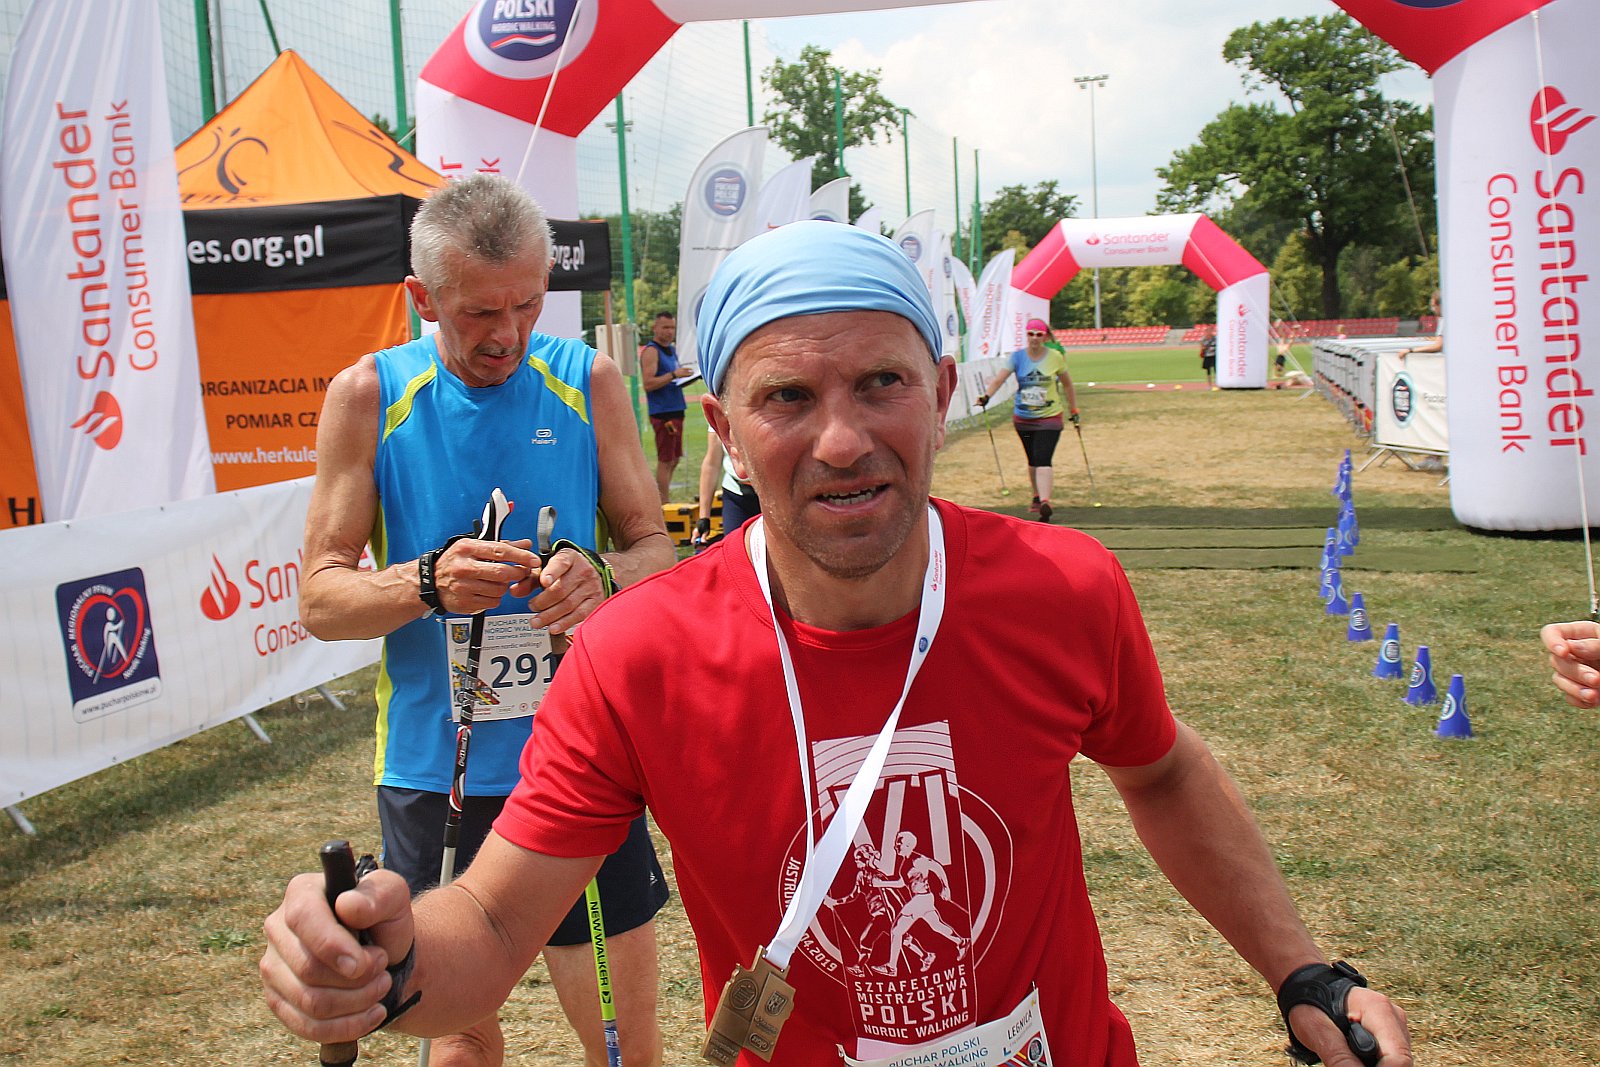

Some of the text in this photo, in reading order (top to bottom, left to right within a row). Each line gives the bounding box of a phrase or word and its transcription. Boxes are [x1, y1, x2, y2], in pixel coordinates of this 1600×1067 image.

[493, 0, 555, 20] POLSKI
[54, 102, 115, 380] Santander
[104, 99, 158, 372] Consumer Bank
[1103, 233, 1168, 245] Santander
[981, 282, 995, 339] Santander
[1487, 172, 1532, 454] Consumer Bank
[1534, 166, 1594, 456] Santander
[1014, 312, 1024, 351] tander
[1238, 320, 1249, 375] Santander
[200, 377, 333, 397] ORGANIZACJA IM
[226, 412, 318, 429] POMIAR CZ
[211, 446, 318, 464] www.herkule
[8, 497, 36, 525] H
[245, 548, 304, 609] San
[255, 620, 313, 656] Consu
[487, 619, 518, 627] PUCHAR
[490, 652, 556, 689] 291
[590, 901, 609, 987] NEW WALKER
[854, 963, 966, 992] SZTAFETOWE
[857, 977, 968, 1005] MISTRZOSTWA
[859, 988, 968, 1025] POLSKI
[863, 1010, 970, 1039] NORDIC WALKING
[1007, 1009, 1033, 1040] LEGNICA
[941, 1036, 981, 1058] POLSKI
